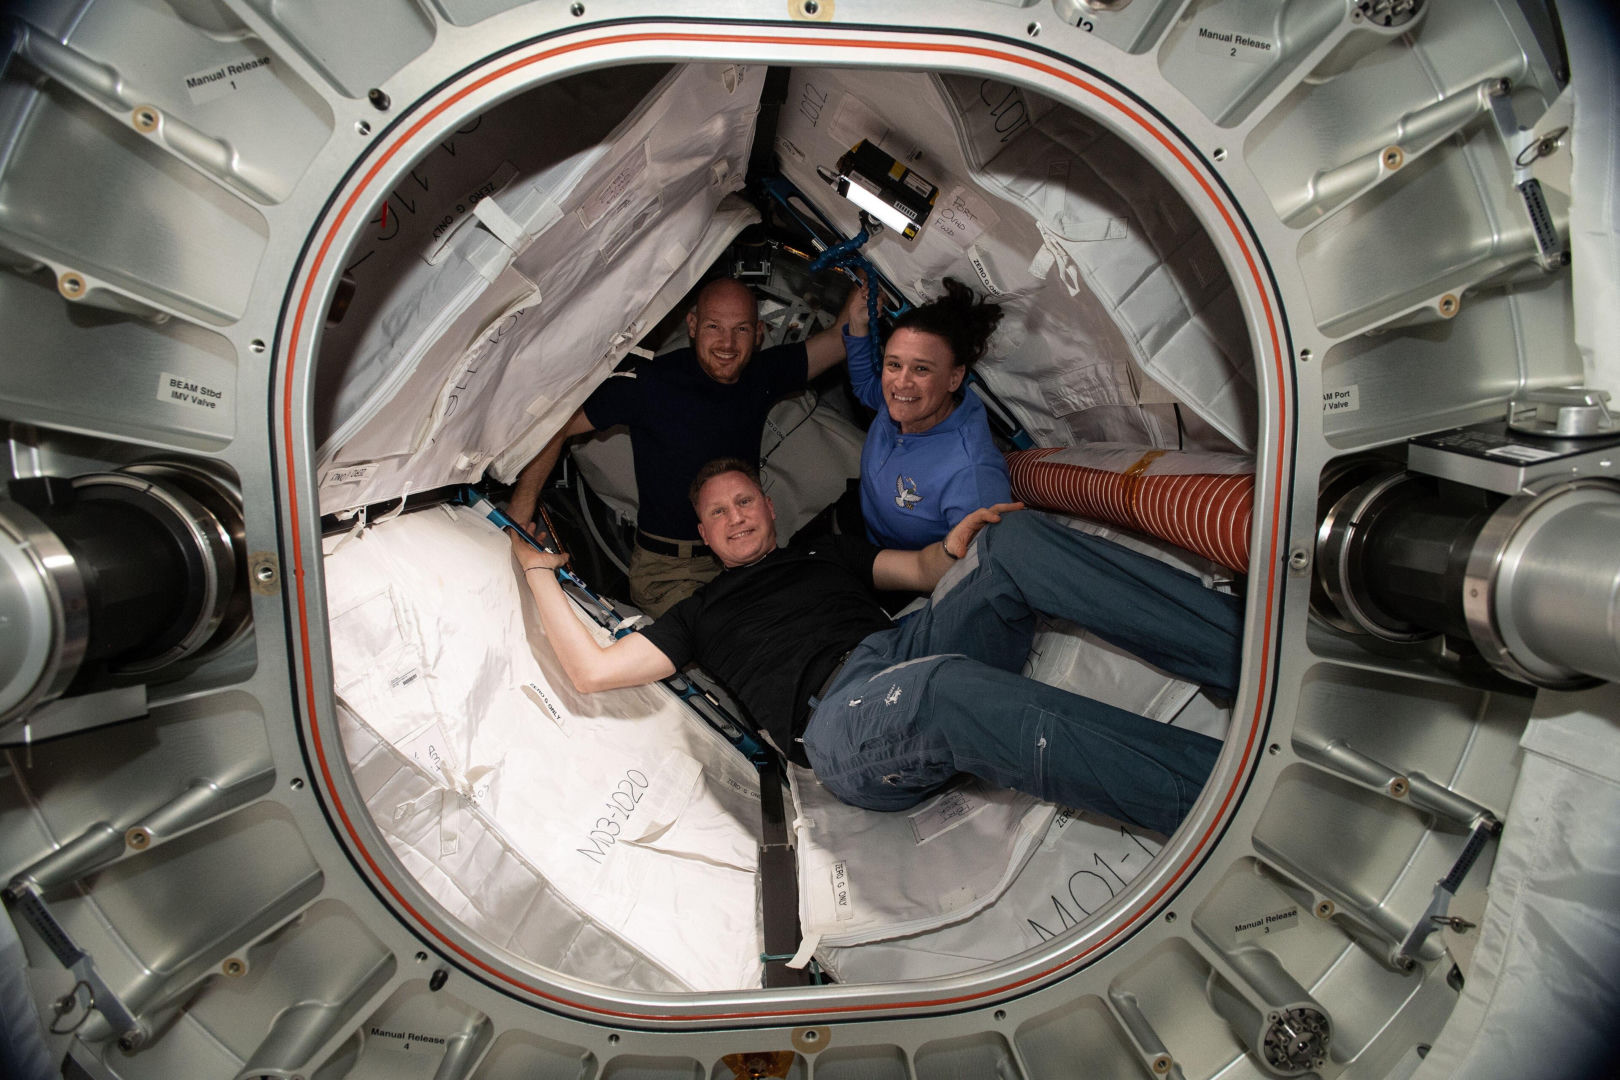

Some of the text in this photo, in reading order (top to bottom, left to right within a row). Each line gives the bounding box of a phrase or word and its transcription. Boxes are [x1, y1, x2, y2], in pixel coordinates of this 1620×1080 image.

[1198, 27, 1272, 51] Manual Release
[1230, 47, 1238, 57] 2
[186, 57, 269, 88] Manual Release
[230, 80, 237, 91] 1
[432, 215, 454, 242] ONLY
[973, 258, 987, 279] ZERO
[169, 378, 223, 399] BEAM Stbd
[1335, 391, 1350, 399] Port
[171, 390, 217, 409] IMV Valve
[1329, 401, 1349, 410] Valve
[547, 703, 562, 720] ONLY
[1234, 910, 1297, 932] Manual Release
[1264, 926, 1270, 934] 3
[371, 1027, 445, 1045] Manual Release
[403, 1042, 410, 1050] 4
